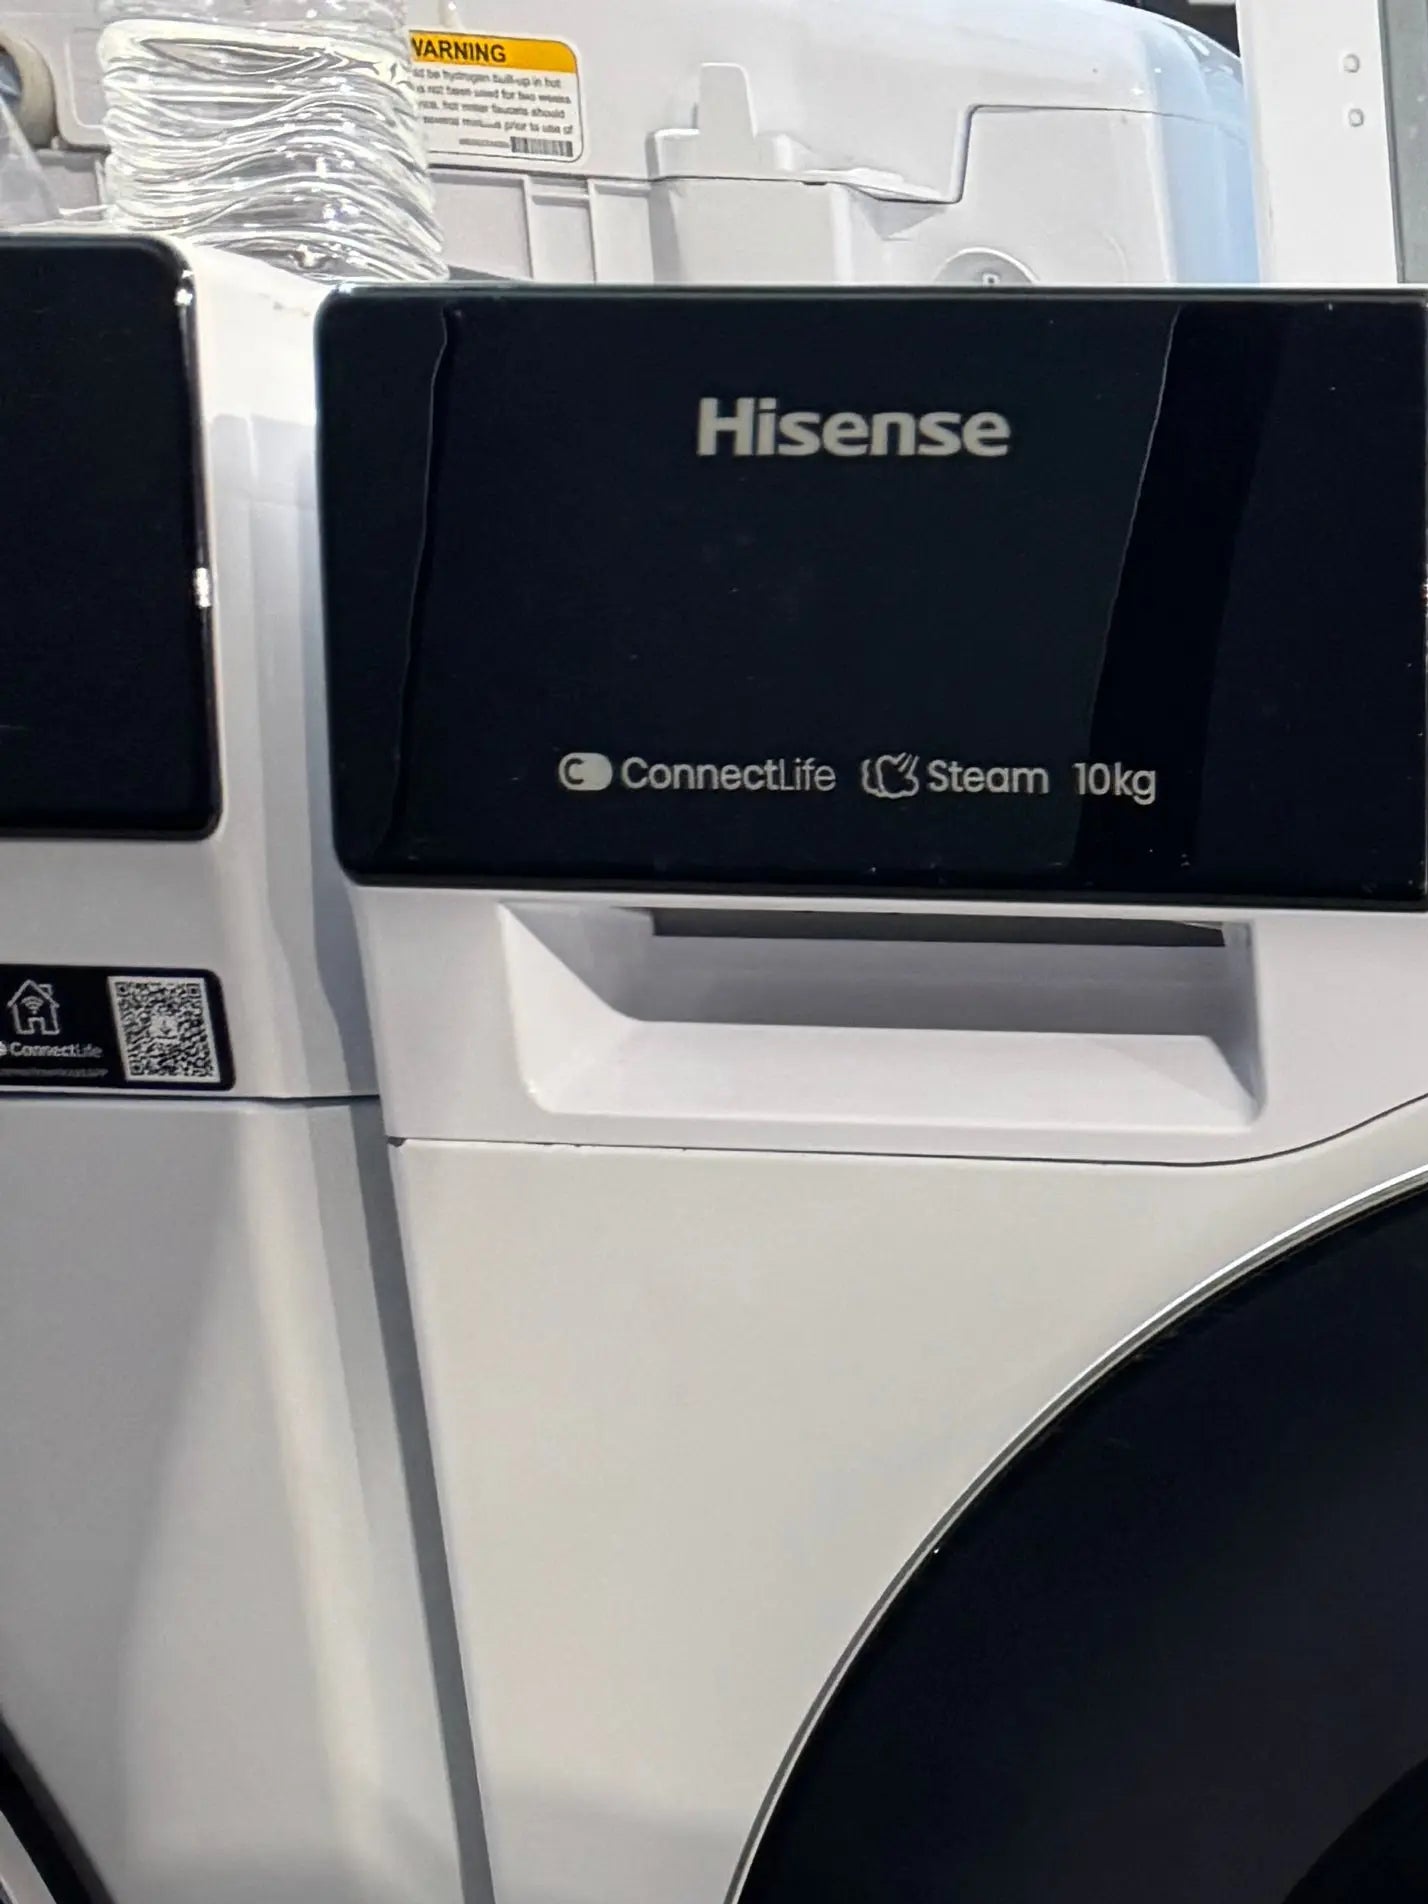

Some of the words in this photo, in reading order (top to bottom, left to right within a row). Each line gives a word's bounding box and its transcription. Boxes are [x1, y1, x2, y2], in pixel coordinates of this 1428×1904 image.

[697, 397, 1011, 456] Hisense
[621, 756, 836, 791] ConnectLife
[929, 760, 1048, 794] Steam
[1074, 762, 1156, 804] 10kg
